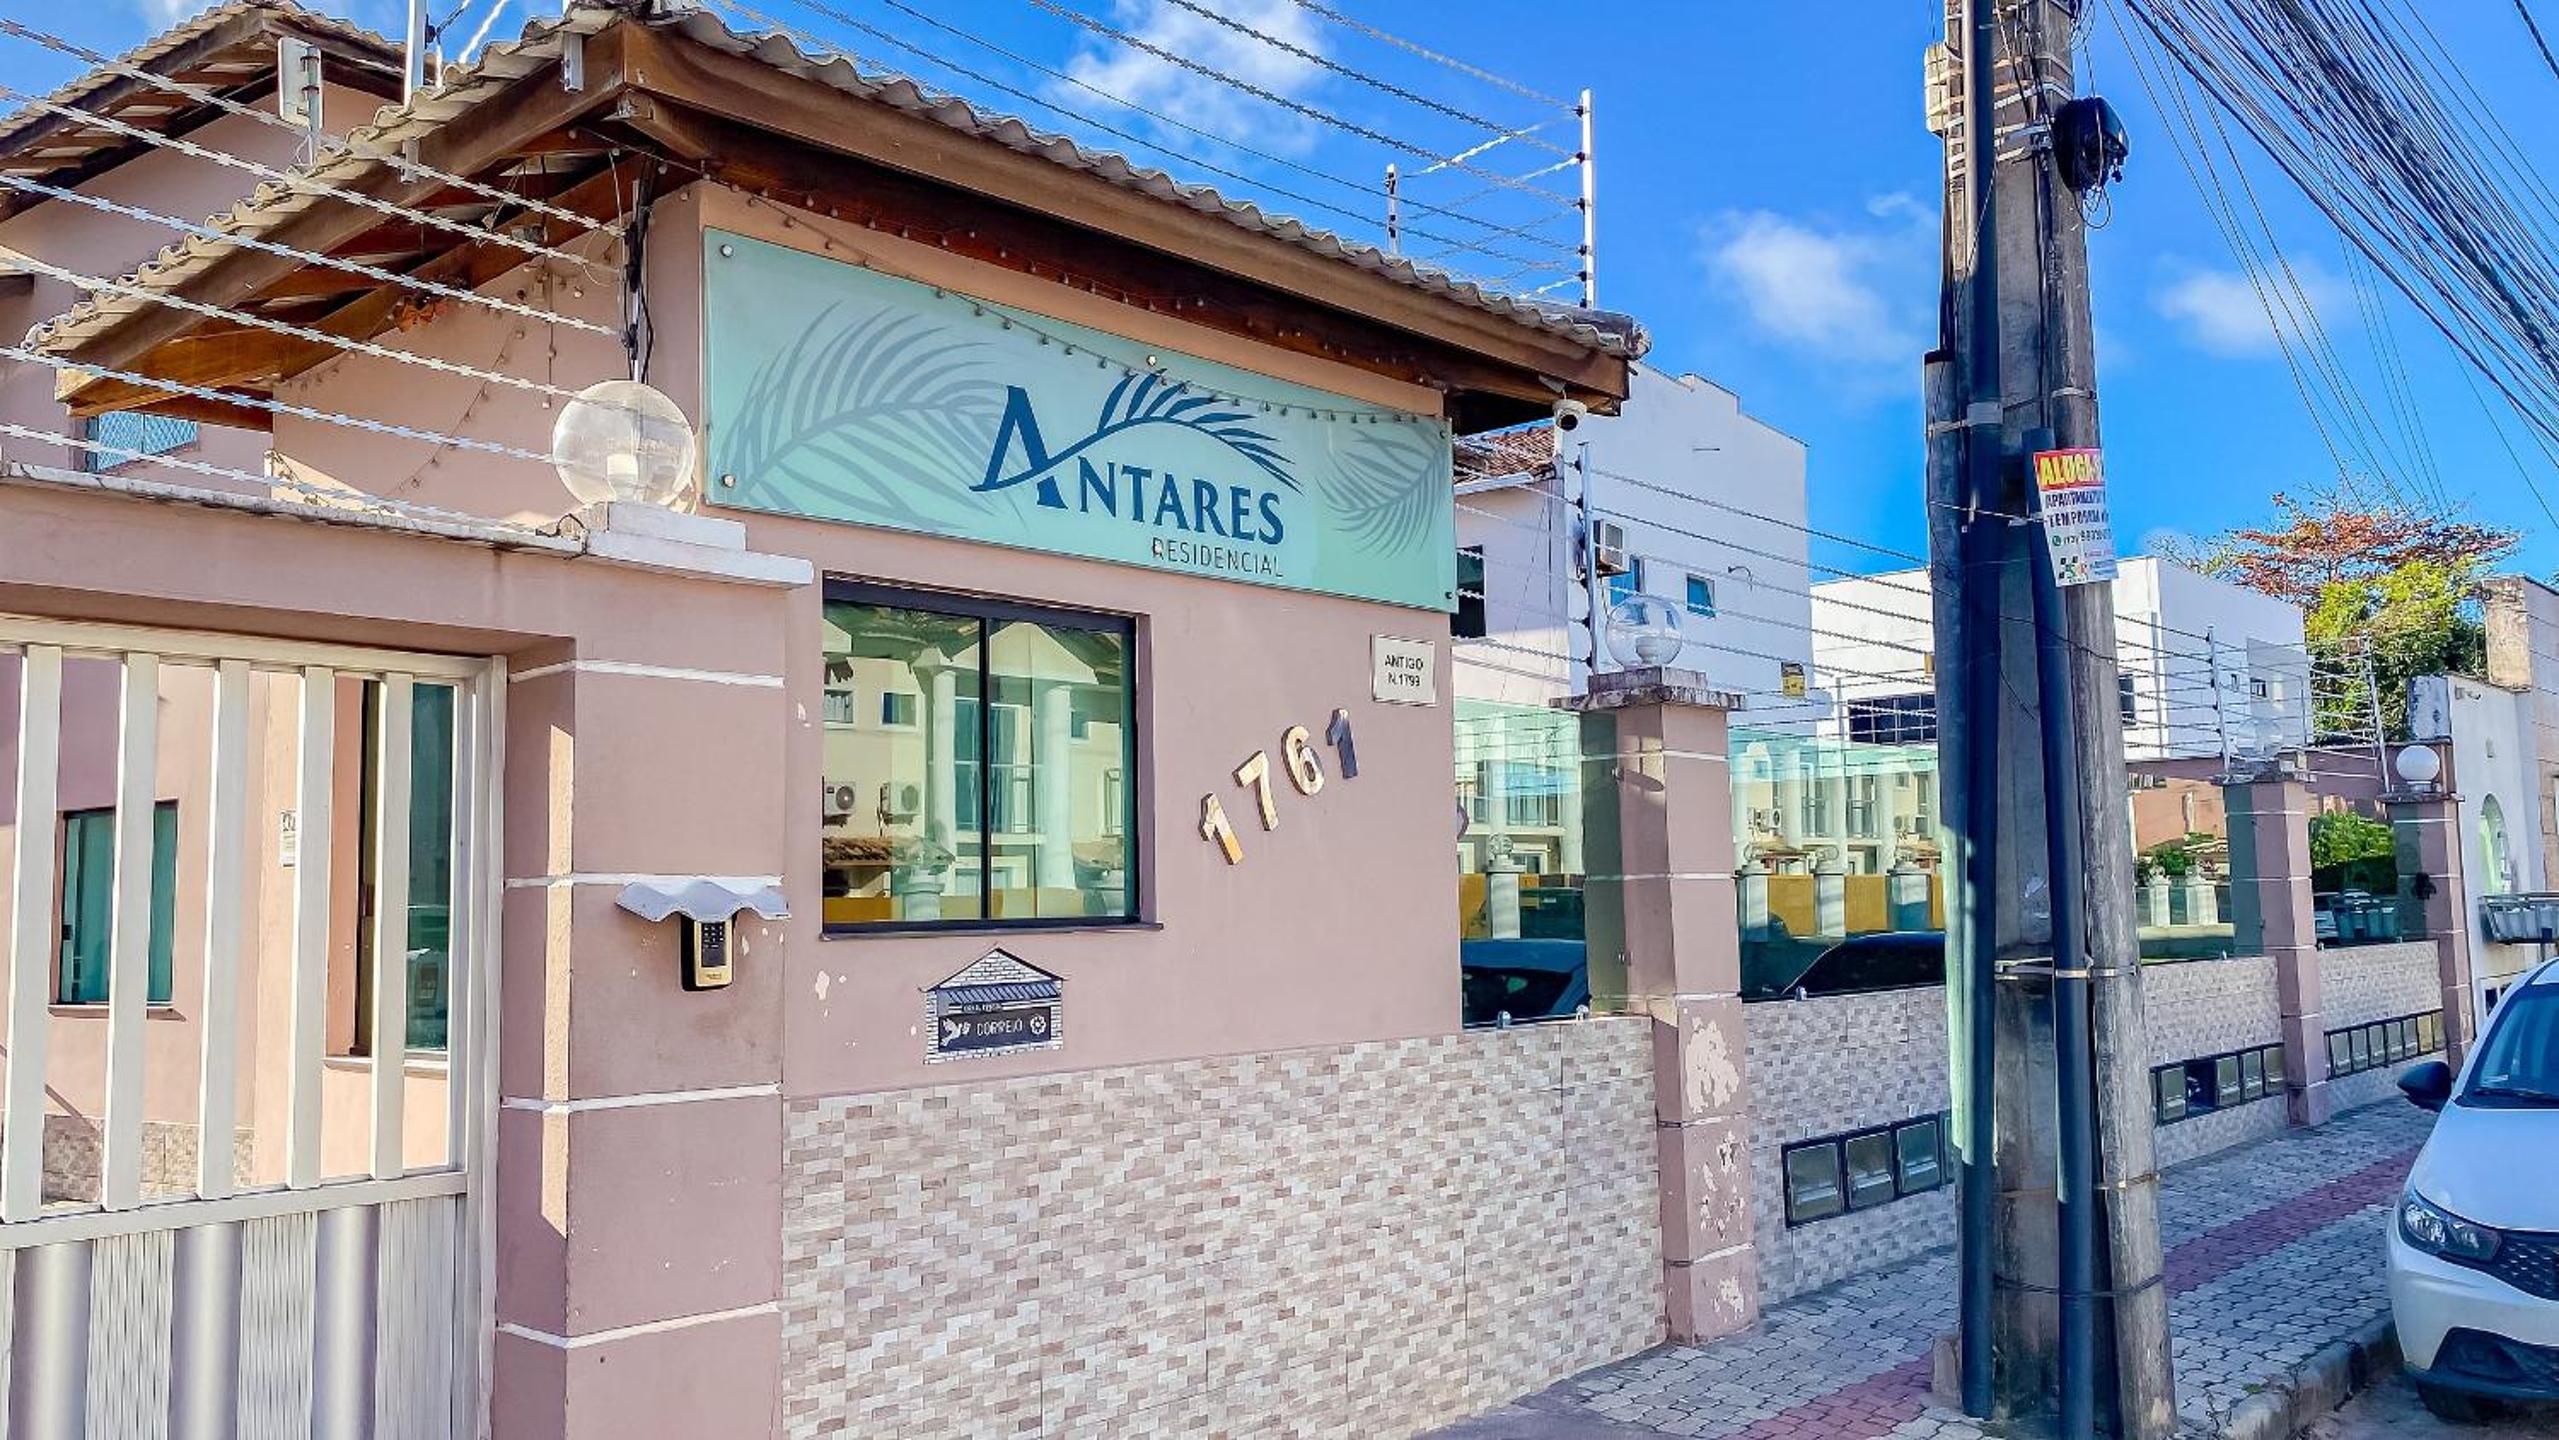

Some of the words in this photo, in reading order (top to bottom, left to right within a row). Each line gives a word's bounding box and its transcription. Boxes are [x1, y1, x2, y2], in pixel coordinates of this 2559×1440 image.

[969, 384, 1285, 546] ANTARES
[1152, 537, 1284, 578] RESIDENCIAL
[1384, 654, 1424, 671] ANTIGO
[1198, 707, 1358, 866] 1761
